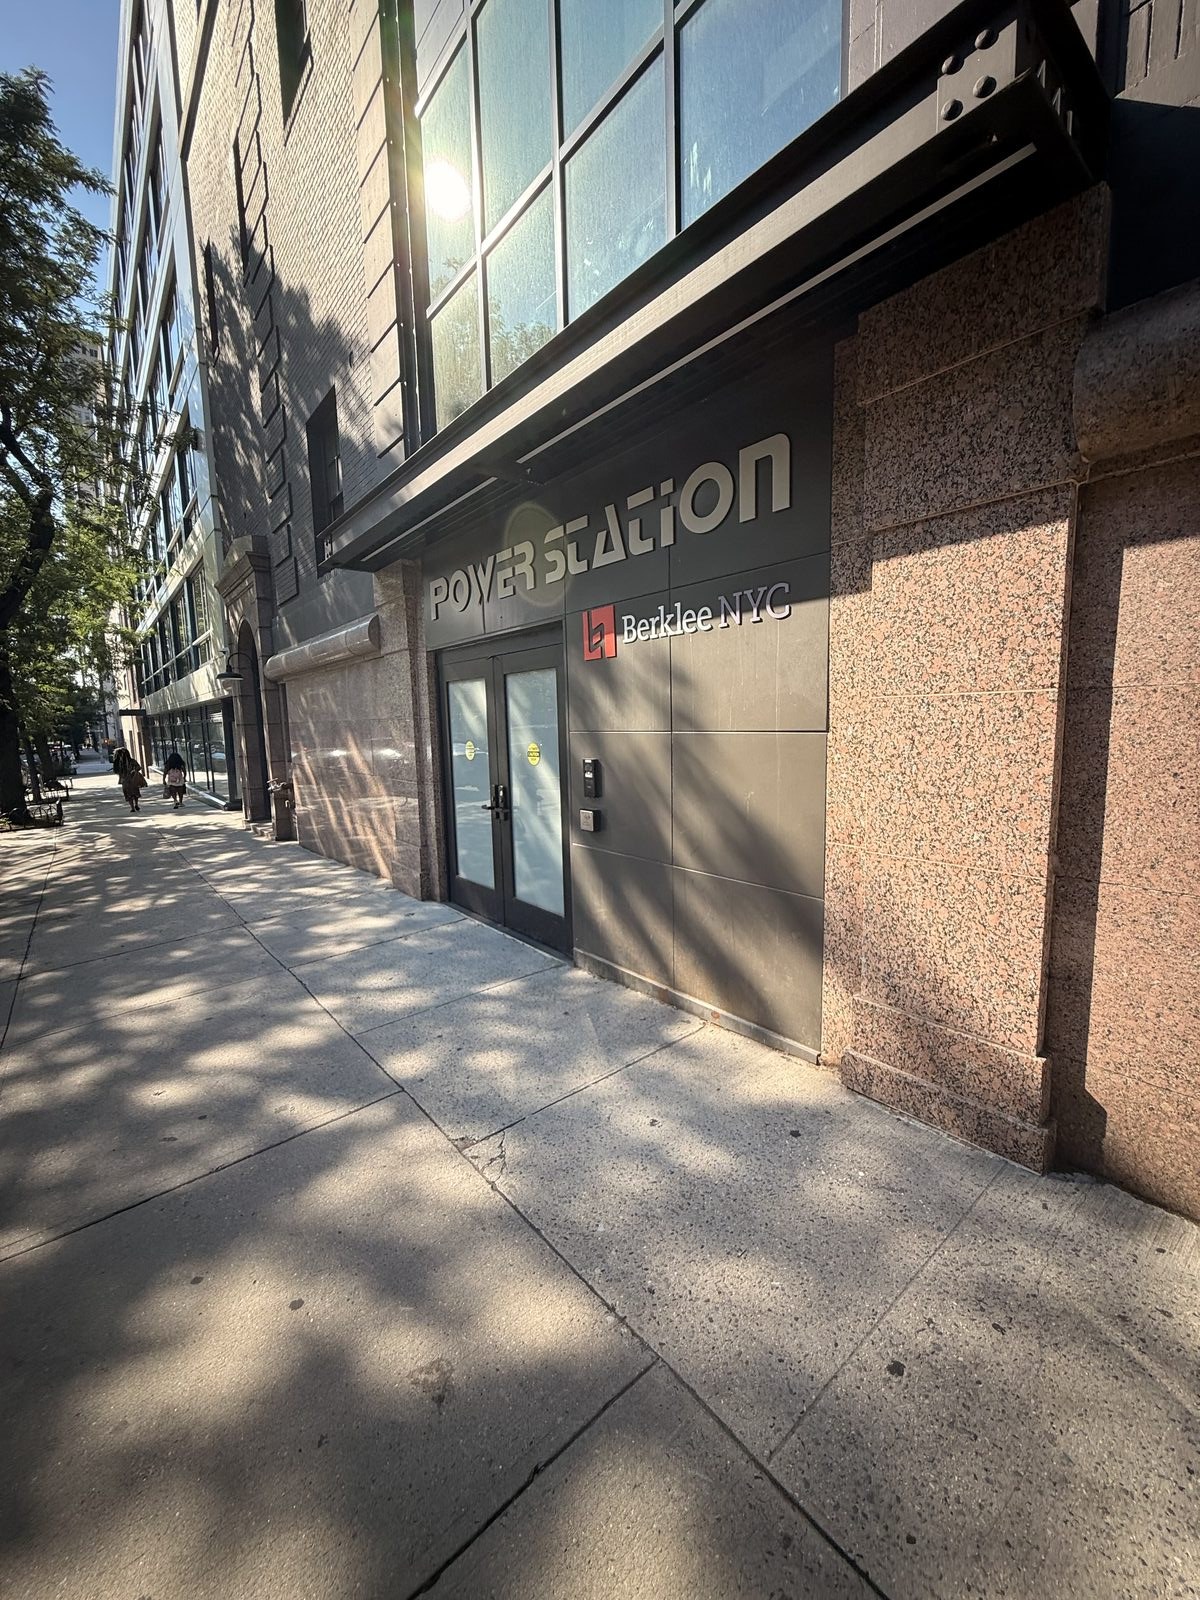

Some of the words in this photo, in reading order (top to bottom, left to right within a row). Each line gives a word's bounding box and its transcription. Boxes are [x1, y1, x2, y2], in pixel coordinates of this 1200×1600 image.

[430, 540, 536, 621] POWER
[622, 603, 713, 643] Berklee
[718, 582, 791, 628] NYC
